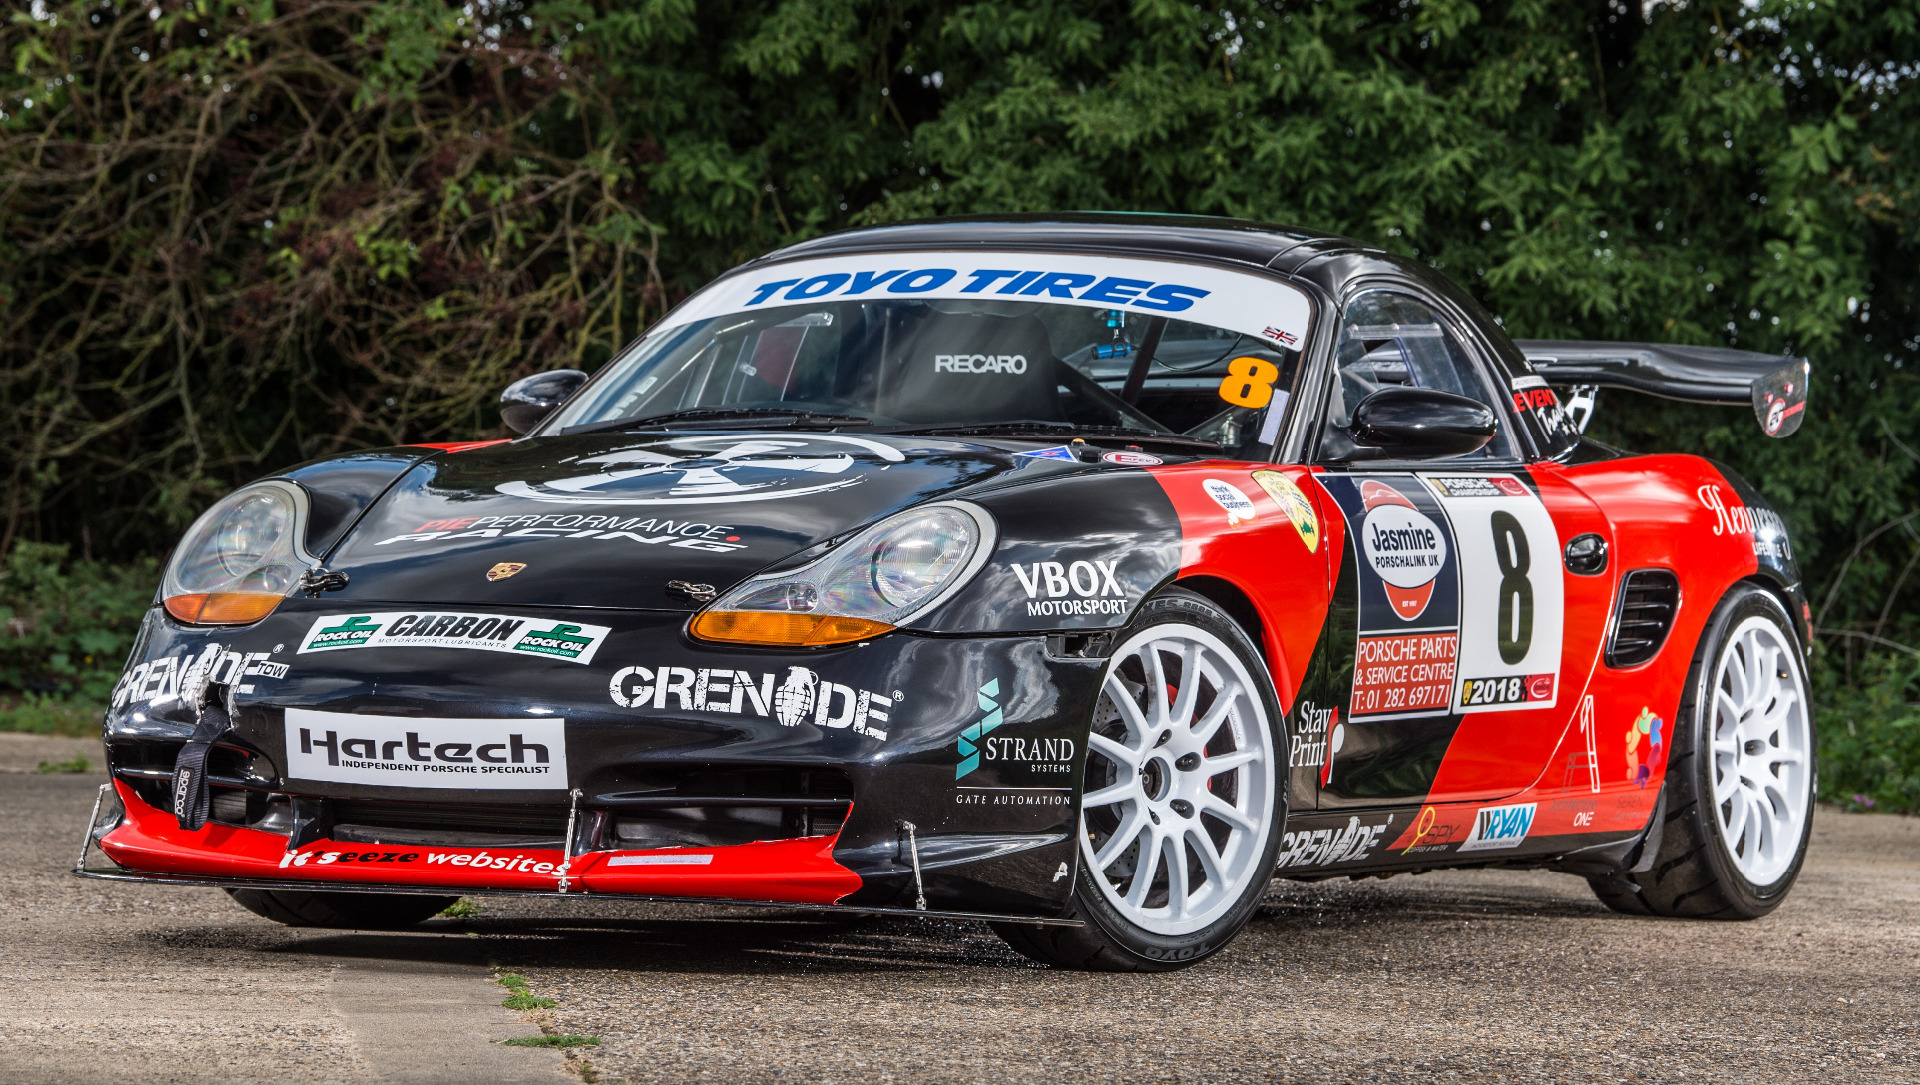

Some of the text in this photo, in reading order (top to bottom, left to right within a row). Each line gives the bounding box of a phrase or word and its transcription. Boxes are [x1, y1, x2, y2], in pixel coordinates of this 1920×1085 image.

[744, 268, 1211, 312] TOYO TIRES
[934, 354, 1027, 376] RECARO
[1218, 357, 1279, 409] 8
[1440, 478, 1495, 488] PORSCHE
[374, 528, 748, 553] RACING
[1371, 521, 1436, 552] Jasmine
[1375, 554, 1439, 569] PORSCHALINK UK
[1010, 560, 1125, 599] VBOX
[1491, 510, 1534, 666] 8
[1027, 599, 1128, 616] MOTORSPORT
[312, 630, 374, 642] ROCK OIL
[384, 614, 525, 642] CARBON
[313, 639, 364, 648] www.rockoil.com
[377, 637, 507, 649] MOTORSPORT LUBRICANTS
[519, 636, 585, 652] ROCK OIL
[519, 645, 575, 657] www.rockoil.com
[1358, 636, 1456, 663] PORSCHE PARTS
[259, 662, 288, 678] TOW
[1355, 662, 1455, 685] & SERVICE CENTRE
[1384, 687, 1406, 708] 282
[1408, 684, 1450, 706] 697171
[1470, 678, 1521, 704] 2018
[610, 665, 893, 742] GRENADE
[1299, 700, 1333, 734] Stay
[299, 727, 550, 767] Hartech
[985, 737, 1075, 762] STRAND
[1289, 735, 1328, 768] Print
[341, 760, 550, 774] INDEPENDENT PORSCHE SPECIALIST
[1031, 764, 1071, 773] SYSTEMS
[174, 769, 191, 816] sparco
[956, 794, 1071, 806] GATE AUTOMATION
[1573, 811, 1594, 827] ONE
[426, 851, 572, 878] websites
[1145, 941, 1210, 960] TOYO
